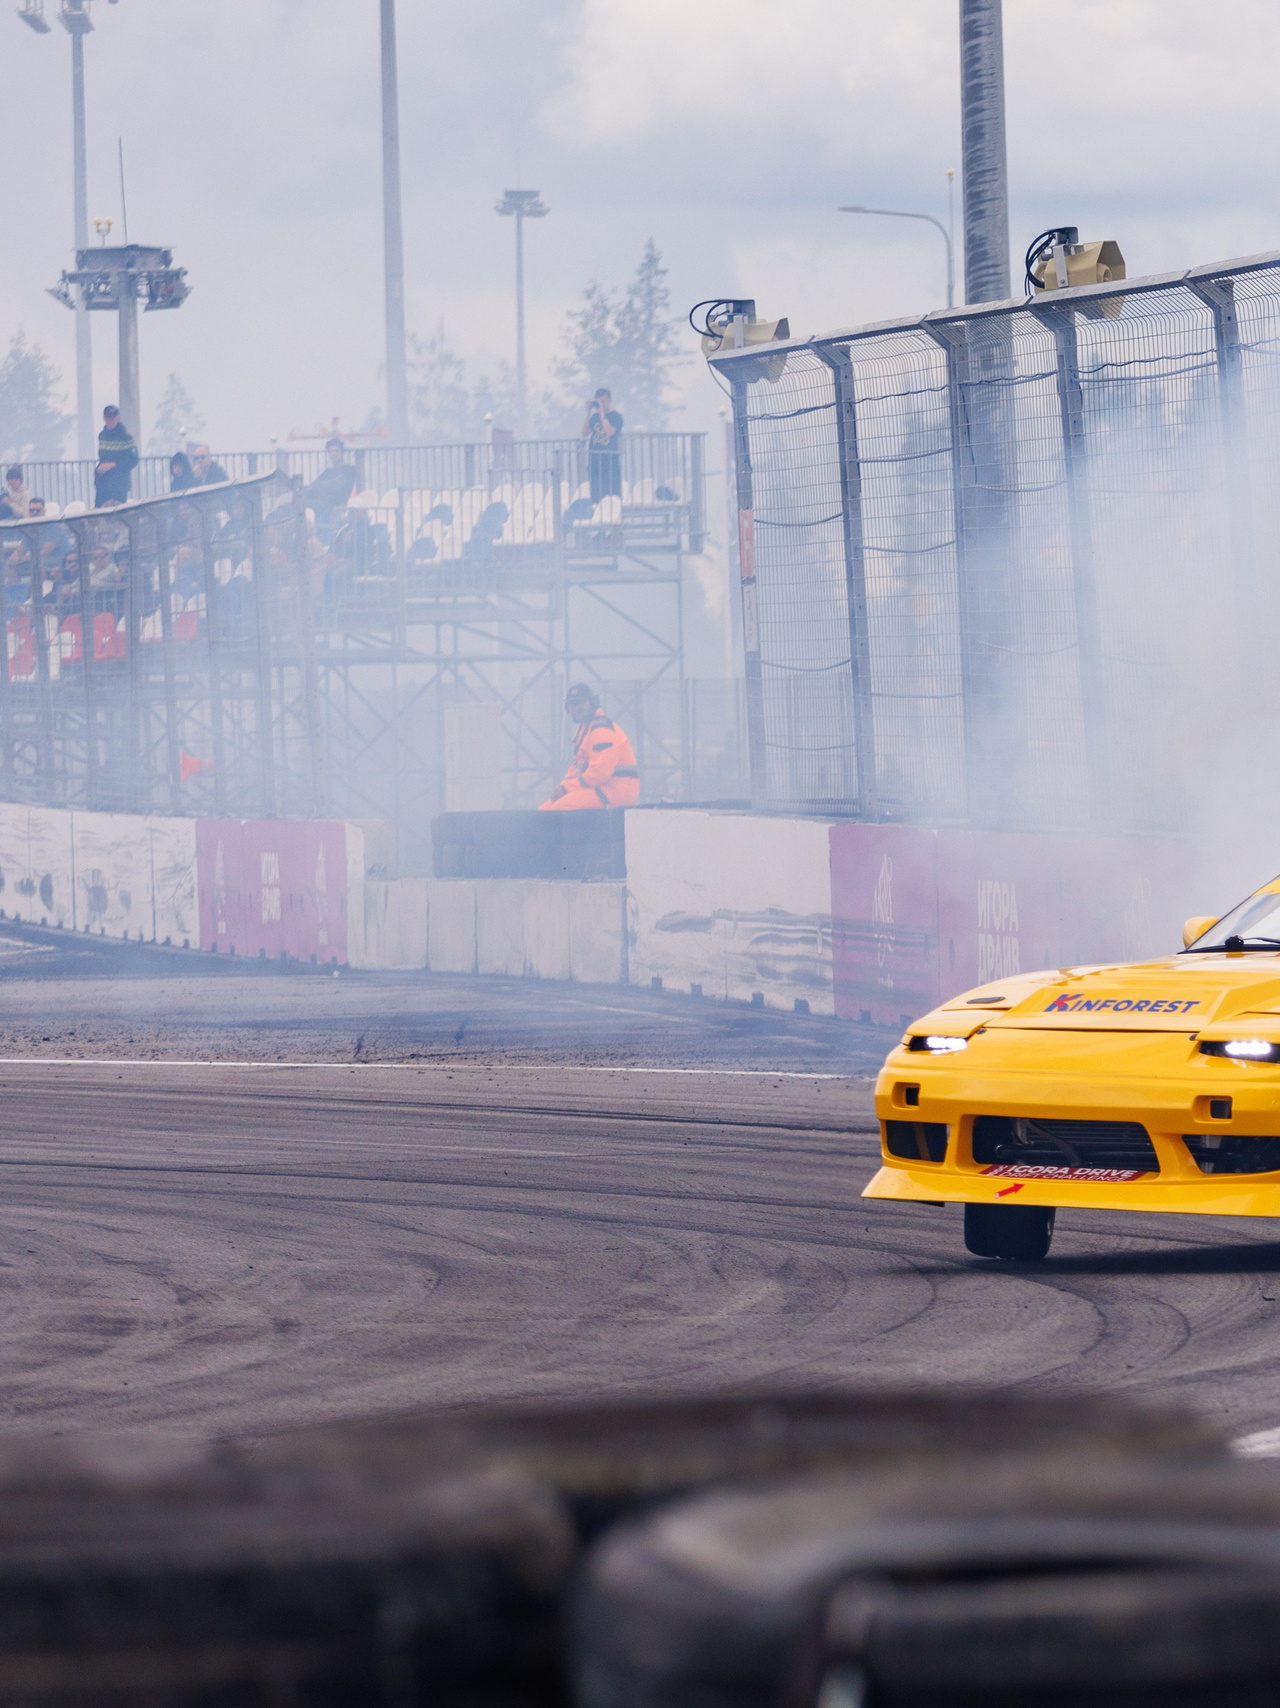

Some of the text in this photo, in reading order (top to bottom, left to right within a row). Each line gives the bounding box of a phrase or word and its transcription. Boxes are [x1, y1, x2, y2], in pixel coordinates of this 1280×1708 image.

[978, 880, 1019, 932] ИГОРА
[1044, 993, 1200, 1013] KINFOREST
[1000, 1171, 1040, 1179] DRIFT
[1042, 1173, 1126, 1182] CHALLENGE
[1008, 1165, 1070, 1174] IGORA
[1074, 1167, 1138, 1178] DRIVE
